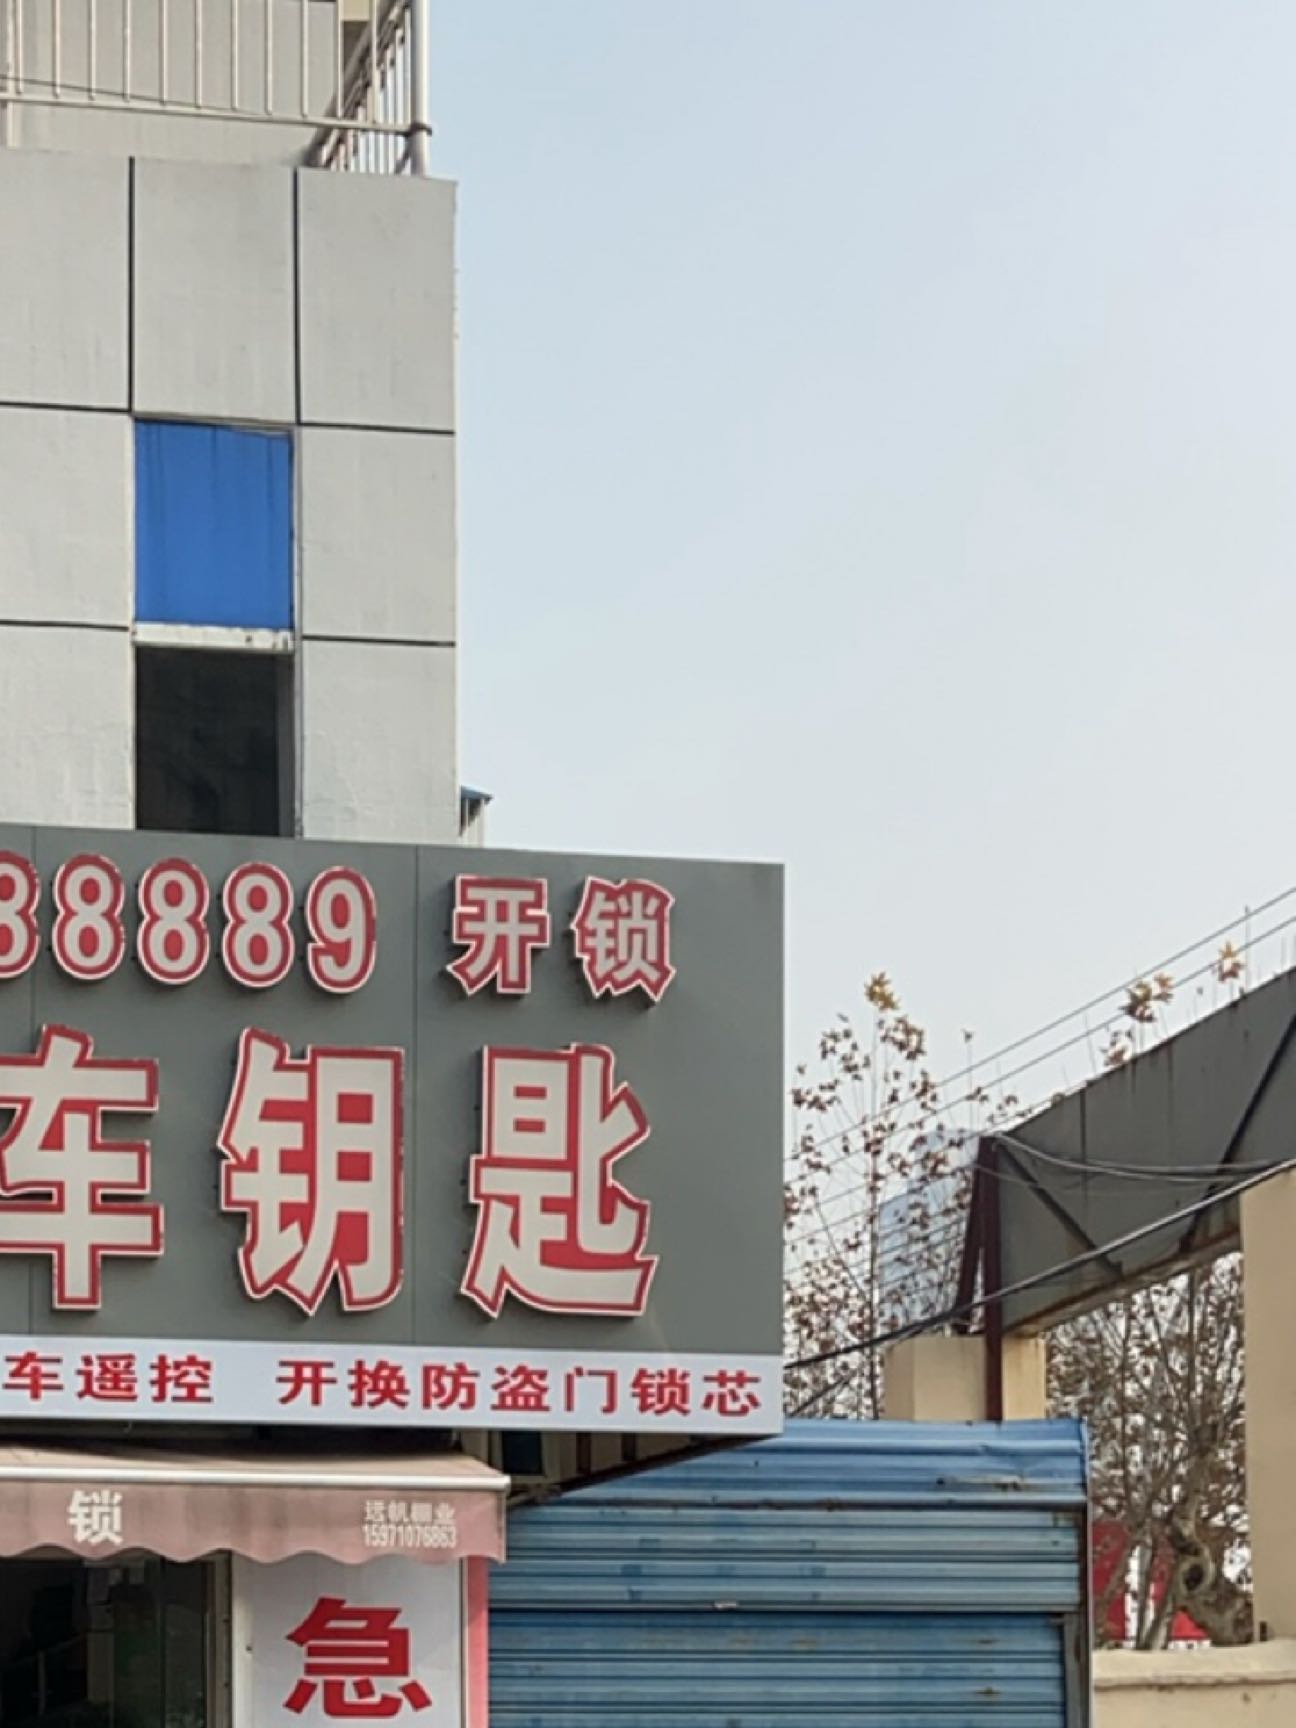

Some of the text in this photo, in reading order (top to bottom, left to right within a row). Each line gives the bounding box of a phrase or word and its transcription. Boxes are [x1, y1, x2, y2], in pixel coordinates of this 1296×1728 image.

[447, 874, 676, 1001] 开锁
[275, 1360, 762, 1417] 开换防盗门锁芯
